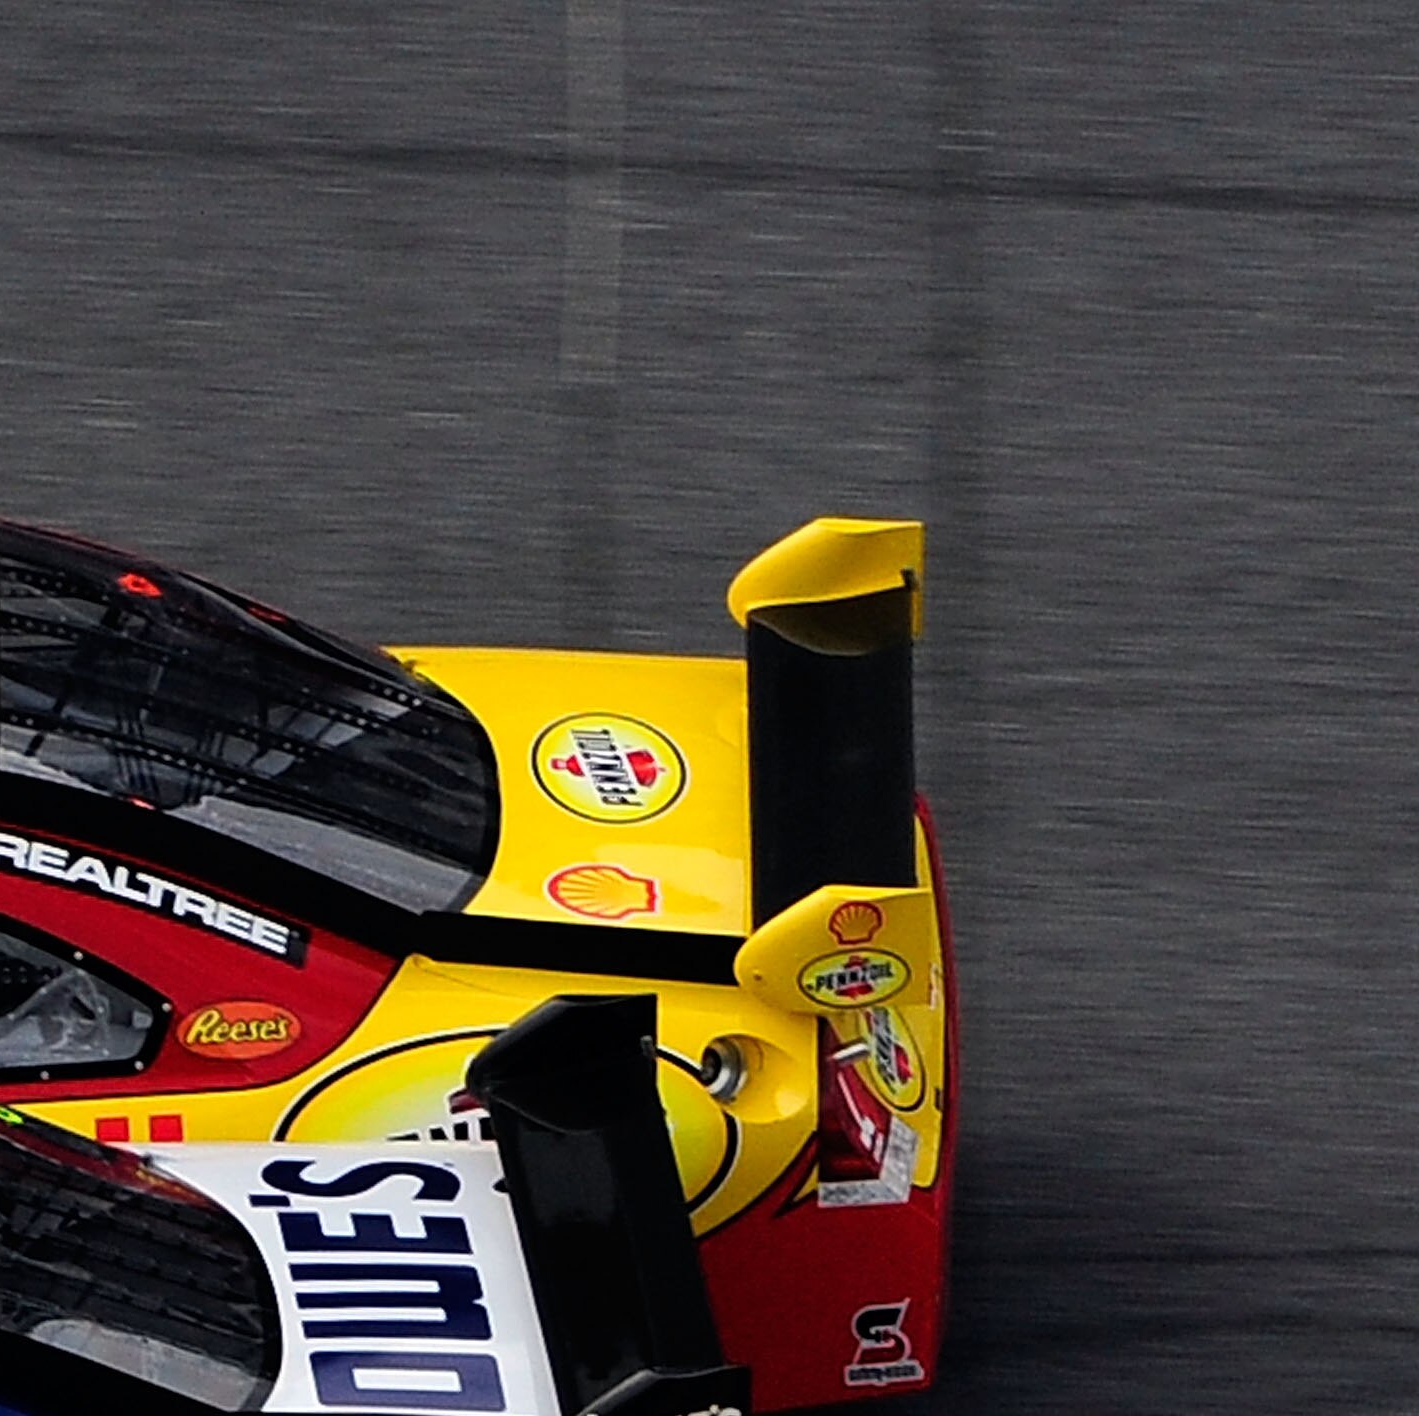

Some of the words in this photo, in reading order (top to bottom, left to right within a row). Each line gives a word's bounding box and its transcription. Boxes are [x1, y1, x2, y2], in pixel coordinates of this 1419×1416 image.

[806, 961, 894, 993] PENNZOIL
[185, 1007, 290, 1048] Reese's
[247, 1159, 507, 1412] OWE'S
